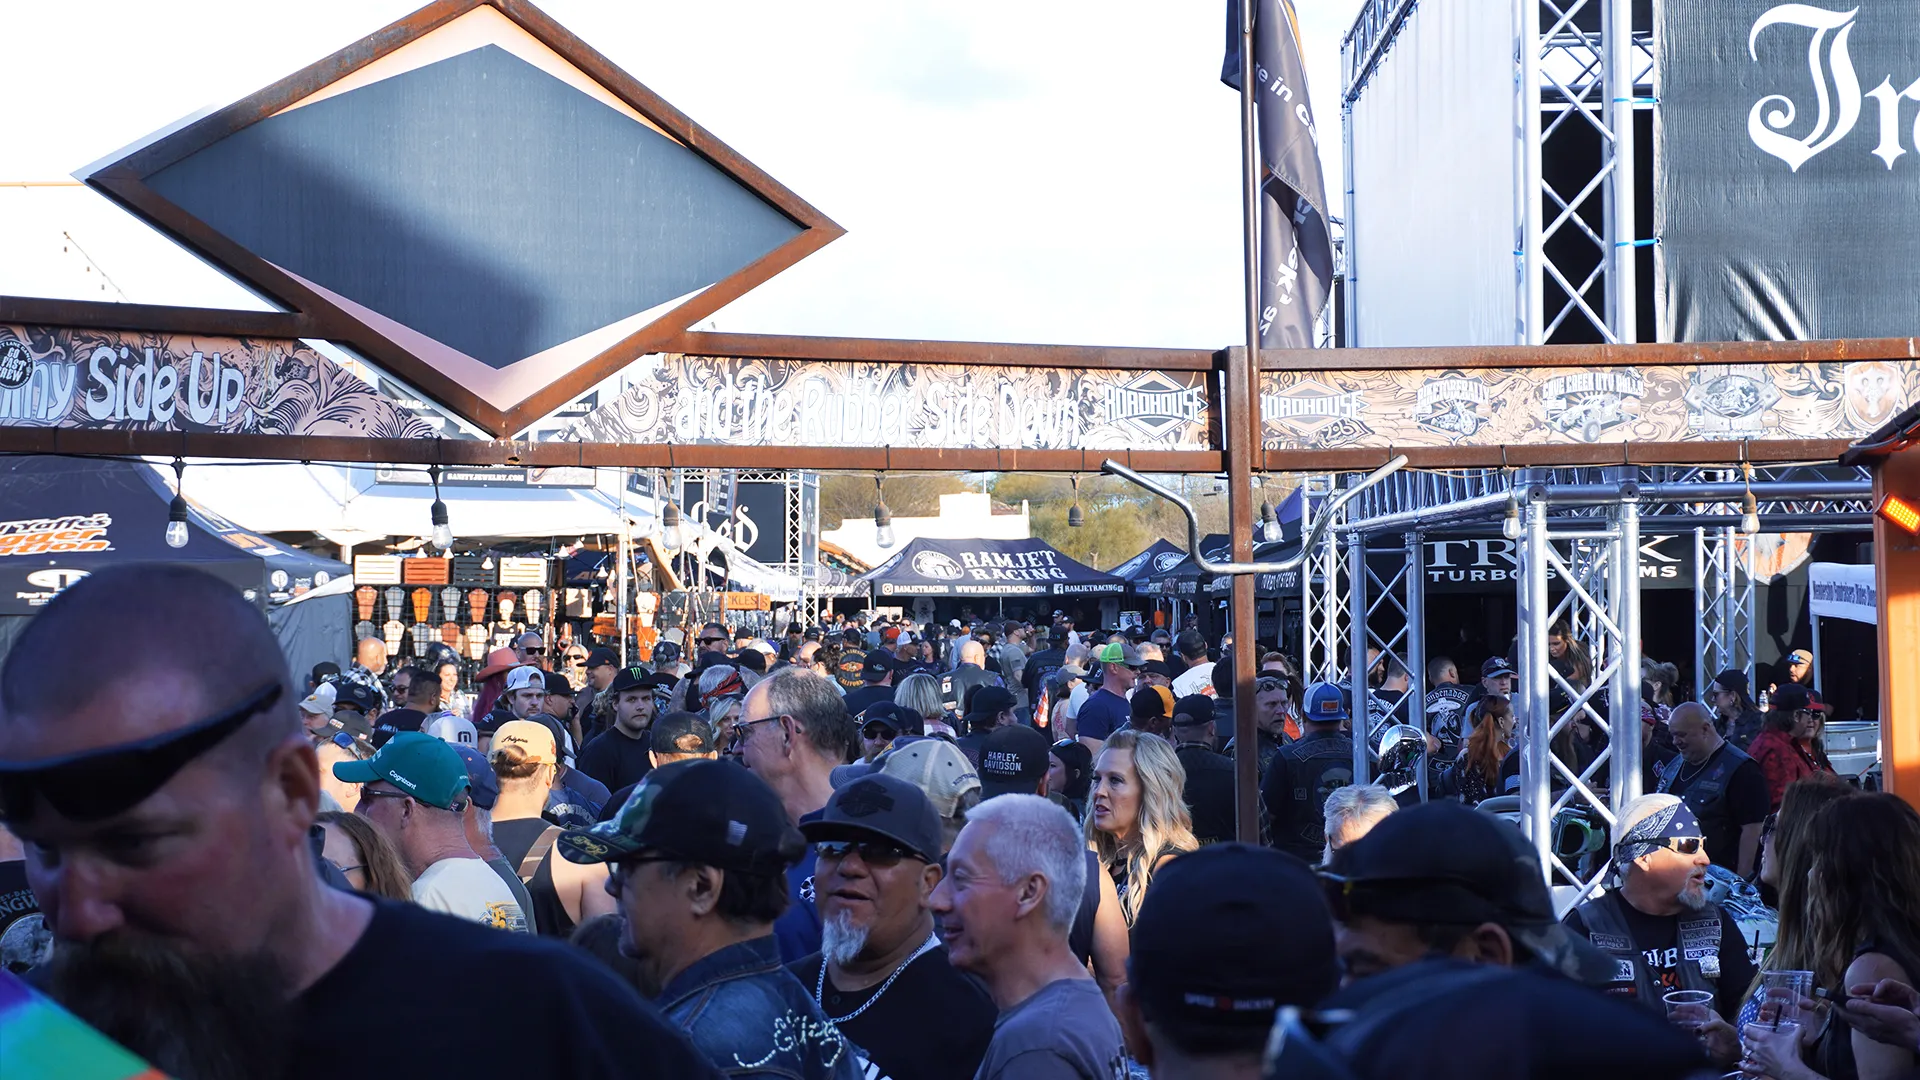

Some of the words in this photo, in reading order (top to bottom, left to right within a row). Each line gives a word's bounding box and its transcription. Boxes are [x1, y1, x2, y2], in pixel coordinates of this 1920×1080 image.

[1269, 75, 1293, 102] in
[7, 347, 20, 359] GO
[1, 356, 26, 371] FAST
[86, 346, 178, 423] Side
[188, 351, 253, 430] Up,
[676, 373, 733, 441] and
[740, 374, 793, 441] the
[800, 377, 916, 444] Rubber
[924, 380, 991, 446] Side
[1103, 382, 1205, 426] ROADHOUSE
[1423, 534, 1682, 567] TRK
[959, 550, 1057, 569] RAMJET
[968, 567, 1068, 581] RACING
[1064, 584, 1118, 593] RAMJETRACING
[1426, 689, 1466, 702] ondenados
[988, 750, 1019, 762] HARLEY-
[389, 769, 417, 790] Cognizant
[1597, 940, 1624, 949] MEMBER
[1686, 940, 1714, 949] ARIZONA
[1687, 950, 1703, 959] ROAD
